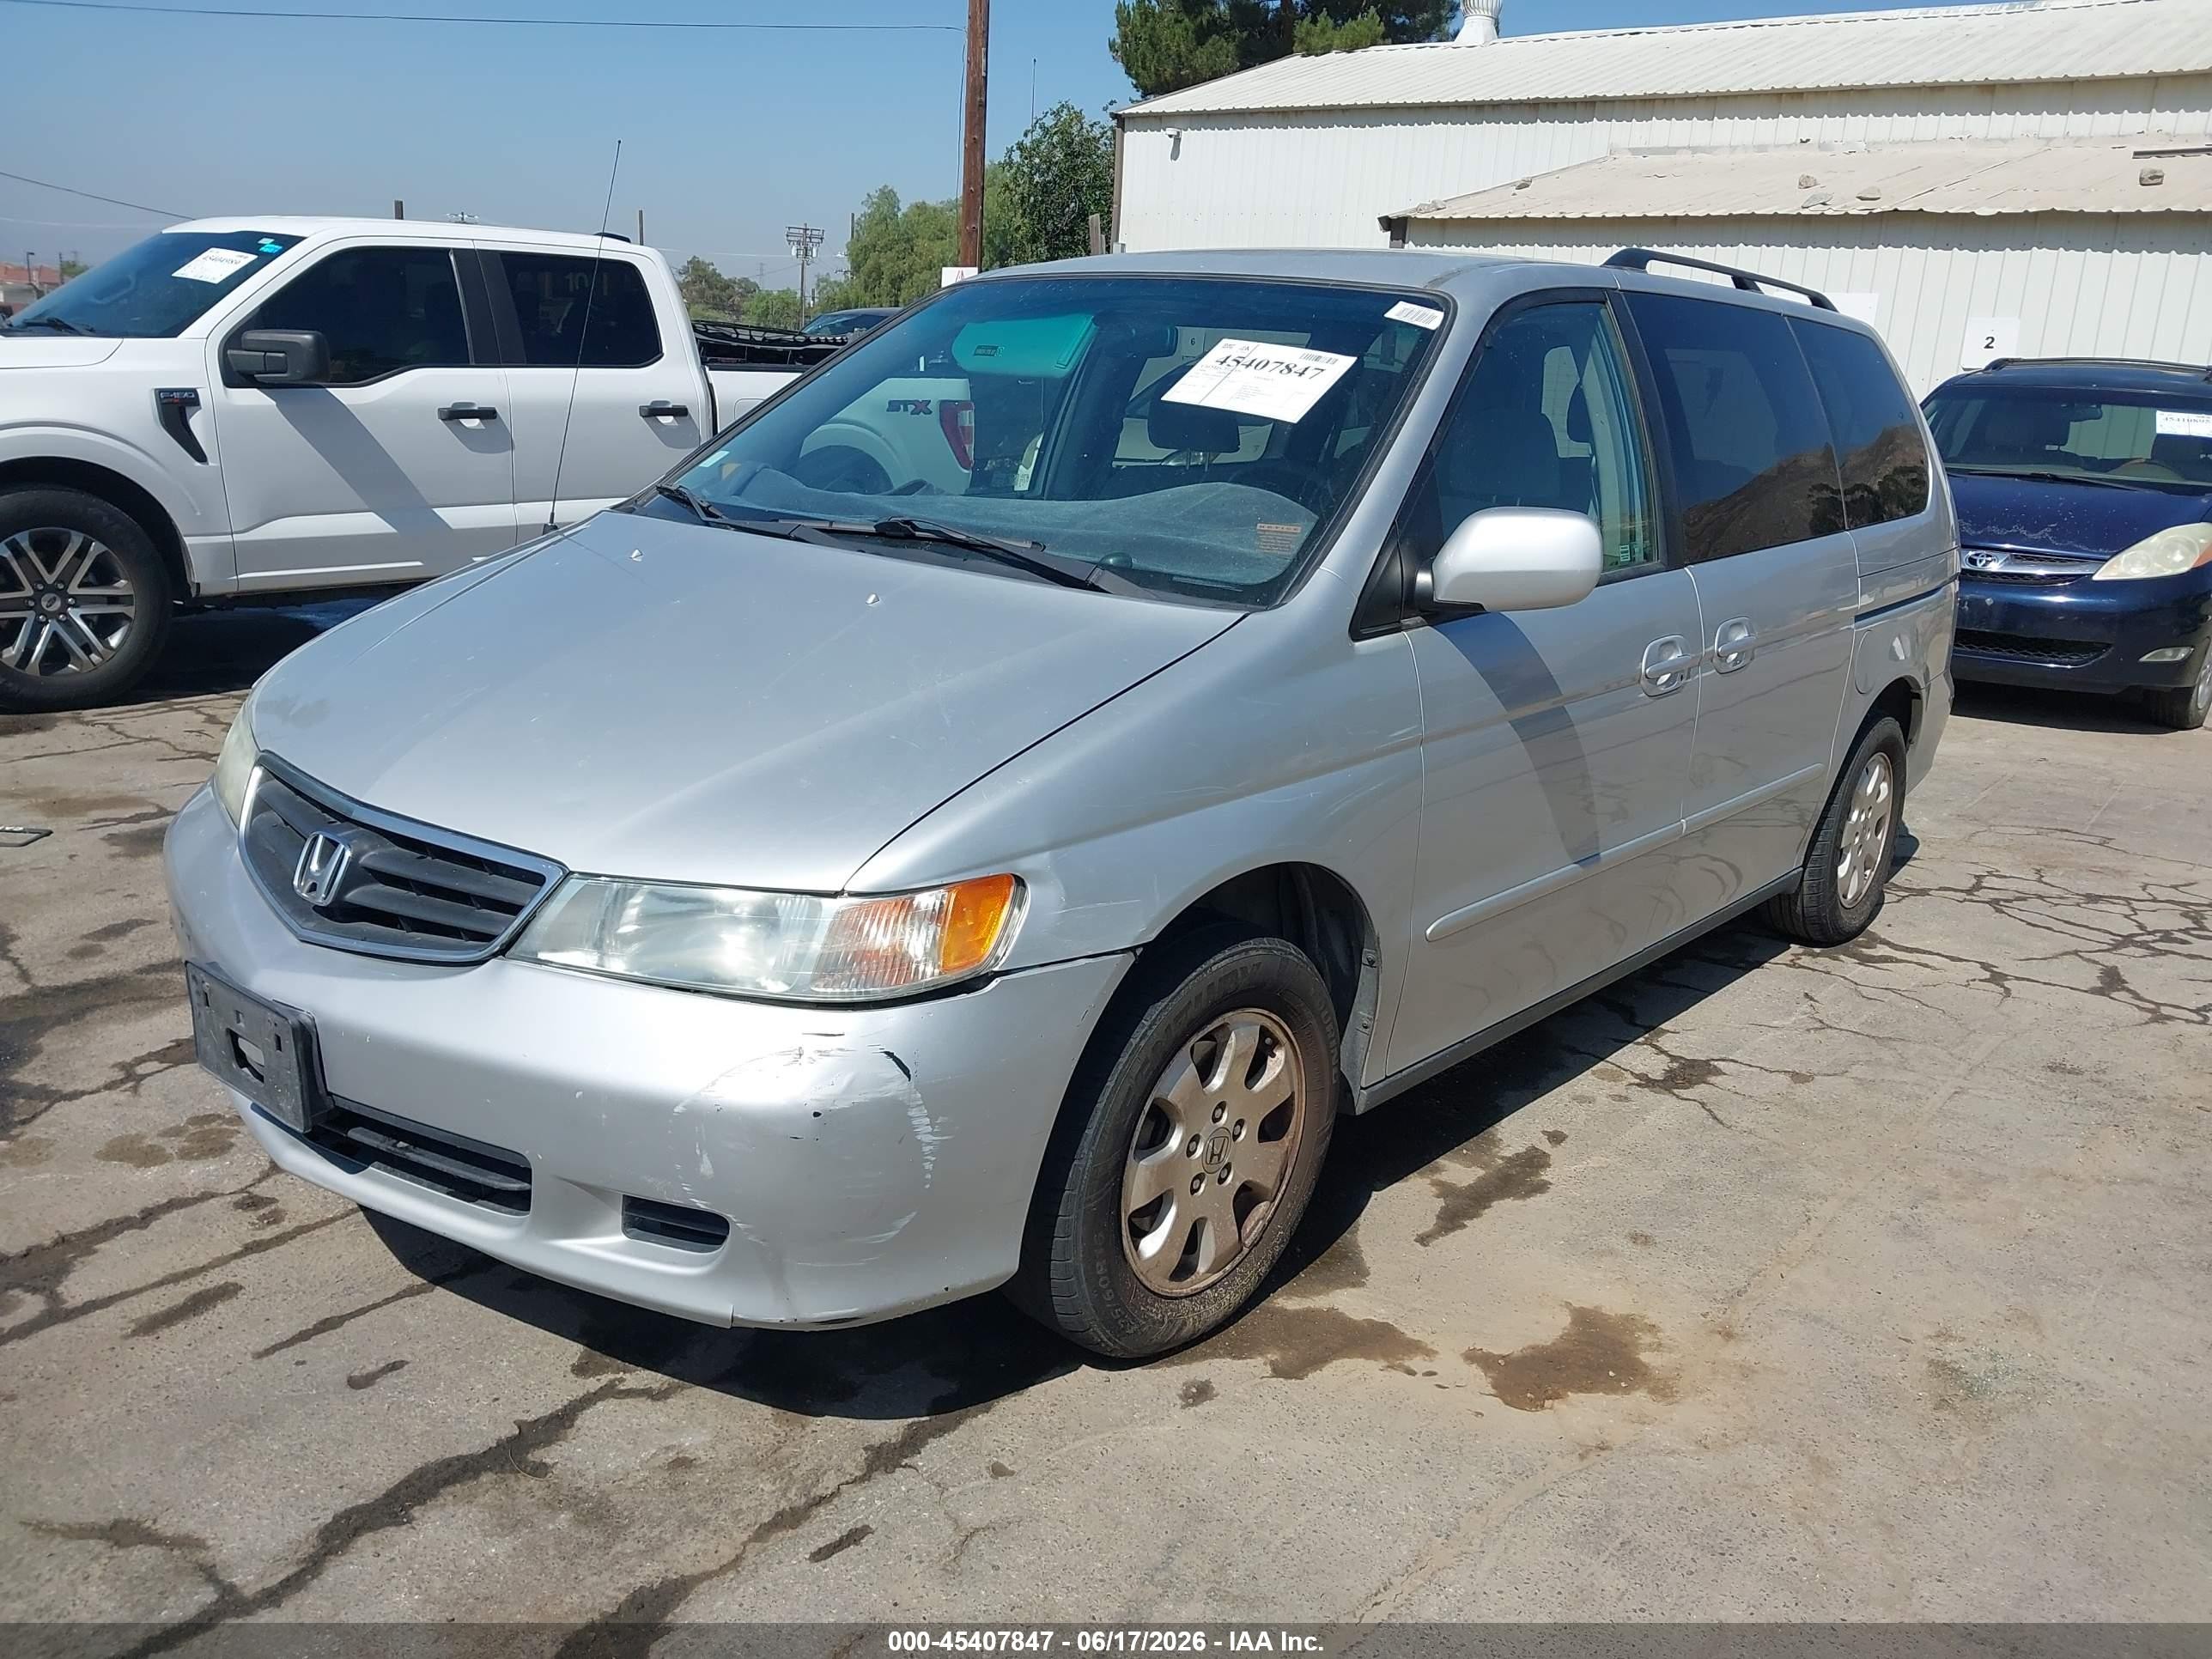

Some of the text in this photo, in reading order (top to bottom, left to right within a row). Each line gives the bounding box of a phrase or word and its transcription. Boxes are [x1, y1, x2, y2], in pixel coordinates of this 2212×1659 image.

[1190, 337, 1196, 346] 6
[1983, 336, 1996, 349] 2
[1215, 354, 1327, 380] 45407847
[886, 399, 933, 416] STX
